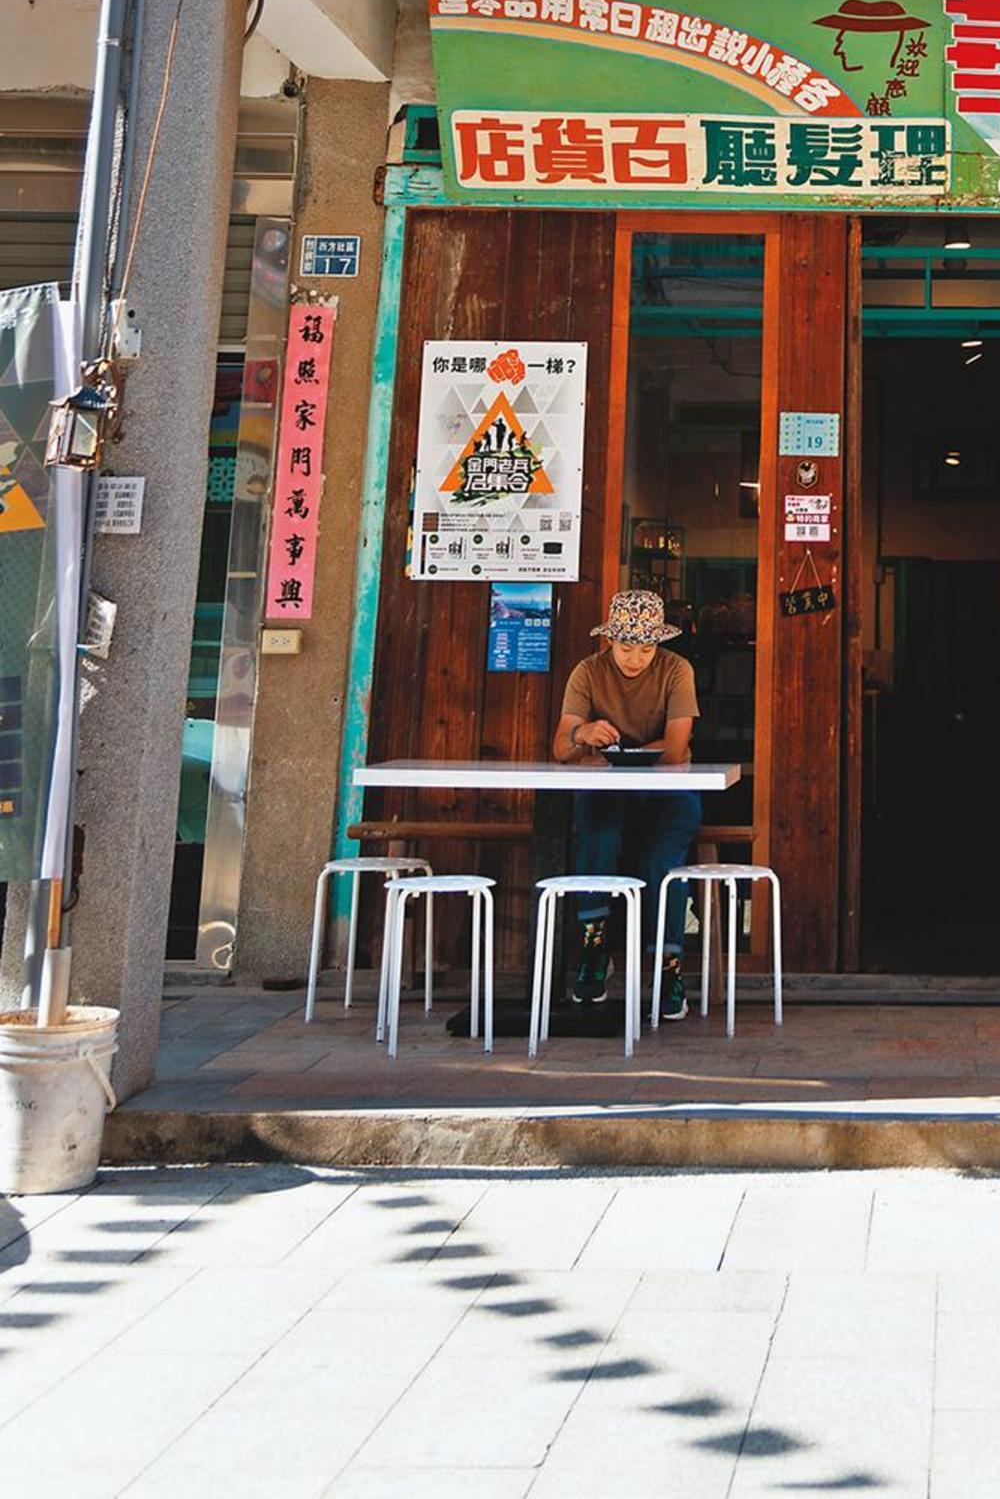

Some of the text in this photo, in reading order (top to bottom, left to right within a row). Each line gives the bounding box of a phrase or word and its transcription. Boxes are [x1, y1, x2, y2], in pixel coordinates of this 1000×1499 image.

[324, 258, 352, 275] 17
[432, 356, 487, 374] 你是哪
[807, 436, 823, 449] 19
[467, 457, 529, 473] 金門老兵
